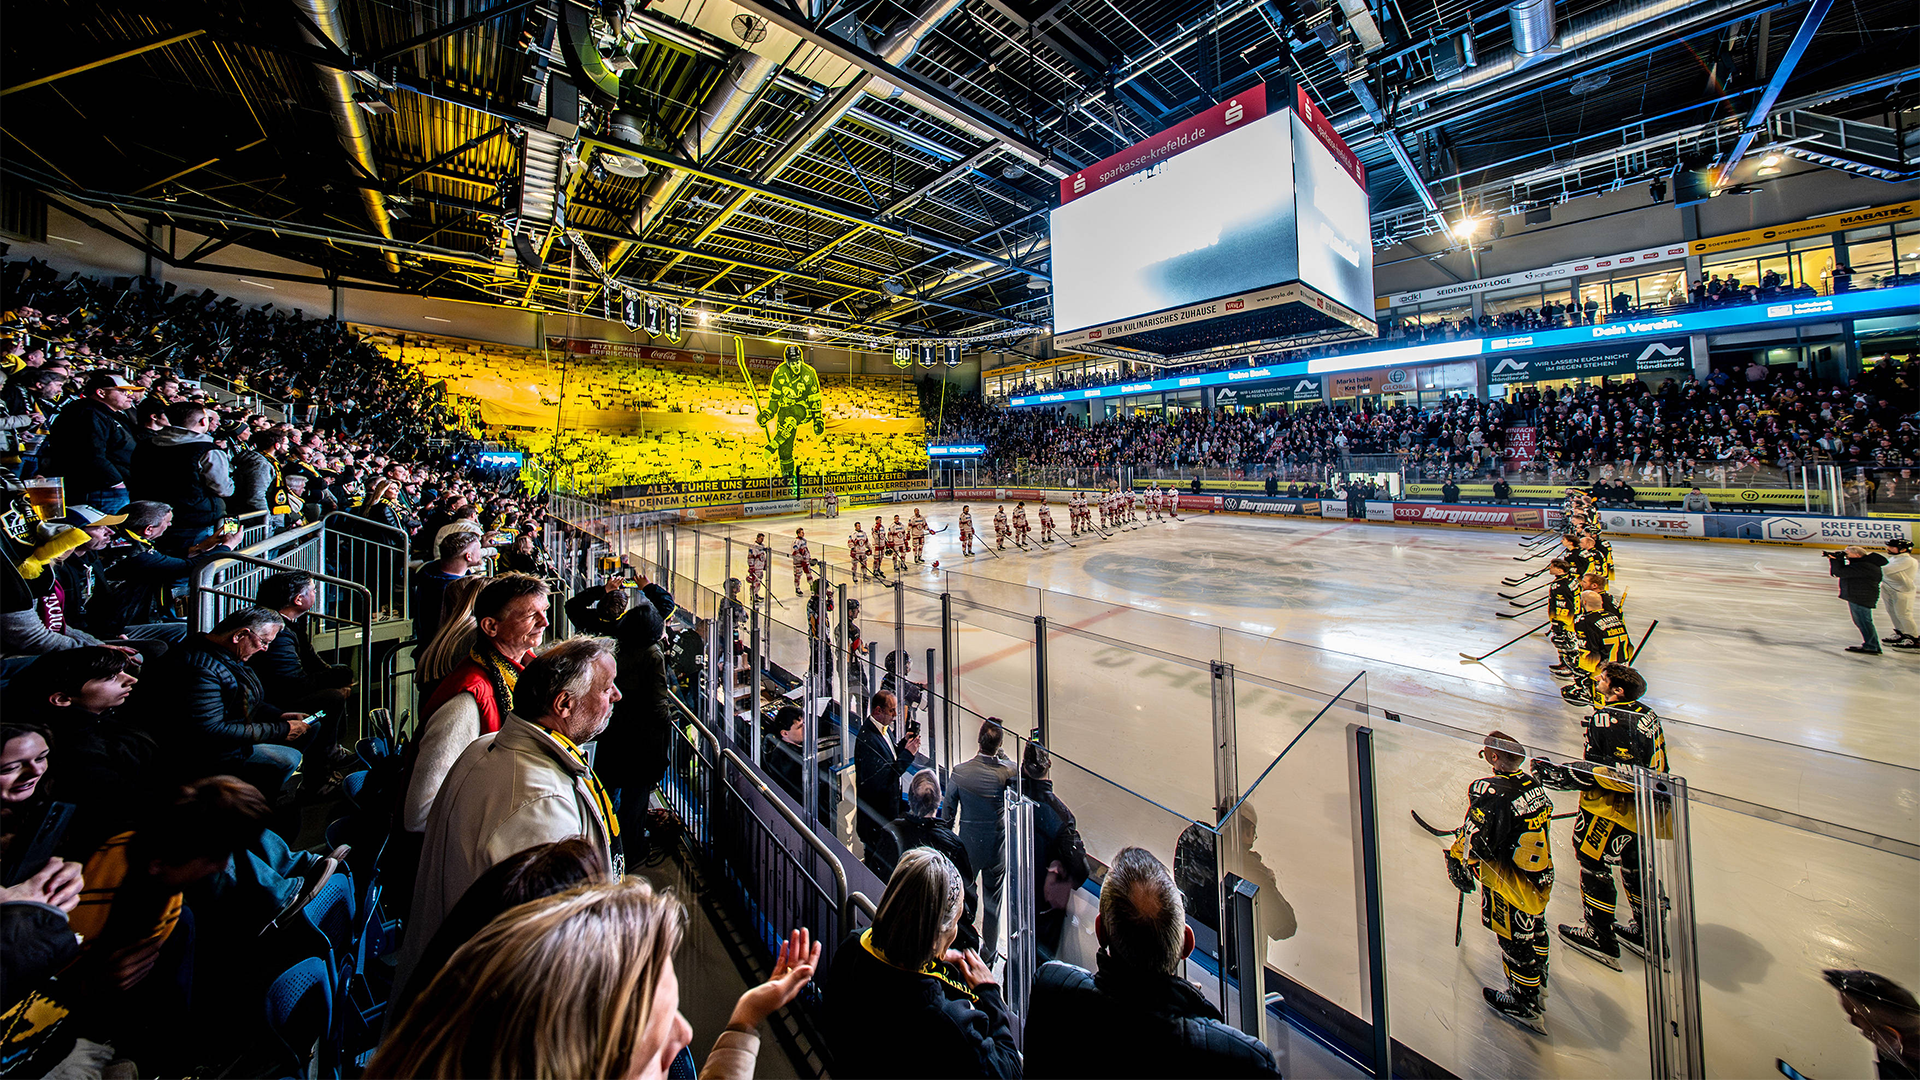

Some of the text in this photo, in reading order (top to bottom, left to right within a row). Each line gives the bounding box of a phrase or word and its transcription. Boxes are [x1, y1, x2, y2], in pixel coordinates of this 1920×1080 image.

[1099, 126, 1206, 183] sparkasse-krefeld.de
[1840, 205, 1913, 225] MABATEC
[1436, 278, 1512, 296] SEIDENSTADT-LOGE
[626, 301, 634, 314] 4
[649, 309, 657, 326] 7
[670, 316, 677, 332] 2
[1107, 305, 1217, 335] DEIN KULINARISCHES ZUHAUSE
[1592, 319, 1682, 337] Dein Verein.
[590, 343, 612, 351] JETZT
[590, 349, 641, 358] ERFRISCHEN!
[895, 348, 910, 360] 80
[1551, 358, 1579, 366] LASSEN
[1580, 356, 1602, 364] EUCH
[1604, 353, 1629, 361] NICHT
[1556, 363, 1582, 371] REGEN
[1583, 361, 1617, 369] STEHEN!
[1637, 362, 1684, 370] Händler.de
[1336, 376, 1373, 385] Markthalle
[1344, 383, 1371, 391] Krefeld
[1383, 382, 1413, 391] GLOBUS
[1505, 433, 1530, 441] NAH
[1504, 447, 1533, 458] DA.
[647, 484, 678, 494] ALEX,
[682, 480, 718, 492] FÜHRE
[721, 479, 743, 489] UNS
[802, 476, 820, 485] DEN
[823, 473, 879, 484] RUHMREICHEN
[880, 472, 907, 480] ZEITEN
[639, 496, 679, 508] DEINEM
[682, 490, 772, 504] SCHWARZ-GELBEN
[847, 483, 864, 492] WIR
[864, 482, 884, 490] ALLES
[885, 479, 927, 488] ERREICHEN
[901, 492, 935, 501] OKUMA
[1239, 500, 1296, 513] Borgmann
[1422, 507, 1509, 523] Borgmann
[1781, 528, 1808, 536] KRB
[1821, 521, 1902, 532] KREFELDER
[1822, 529, 1905, 539] BAU GMBH
[1603, 634, 1629, 662] 77
[1512, 829, 1549, 872] 8
